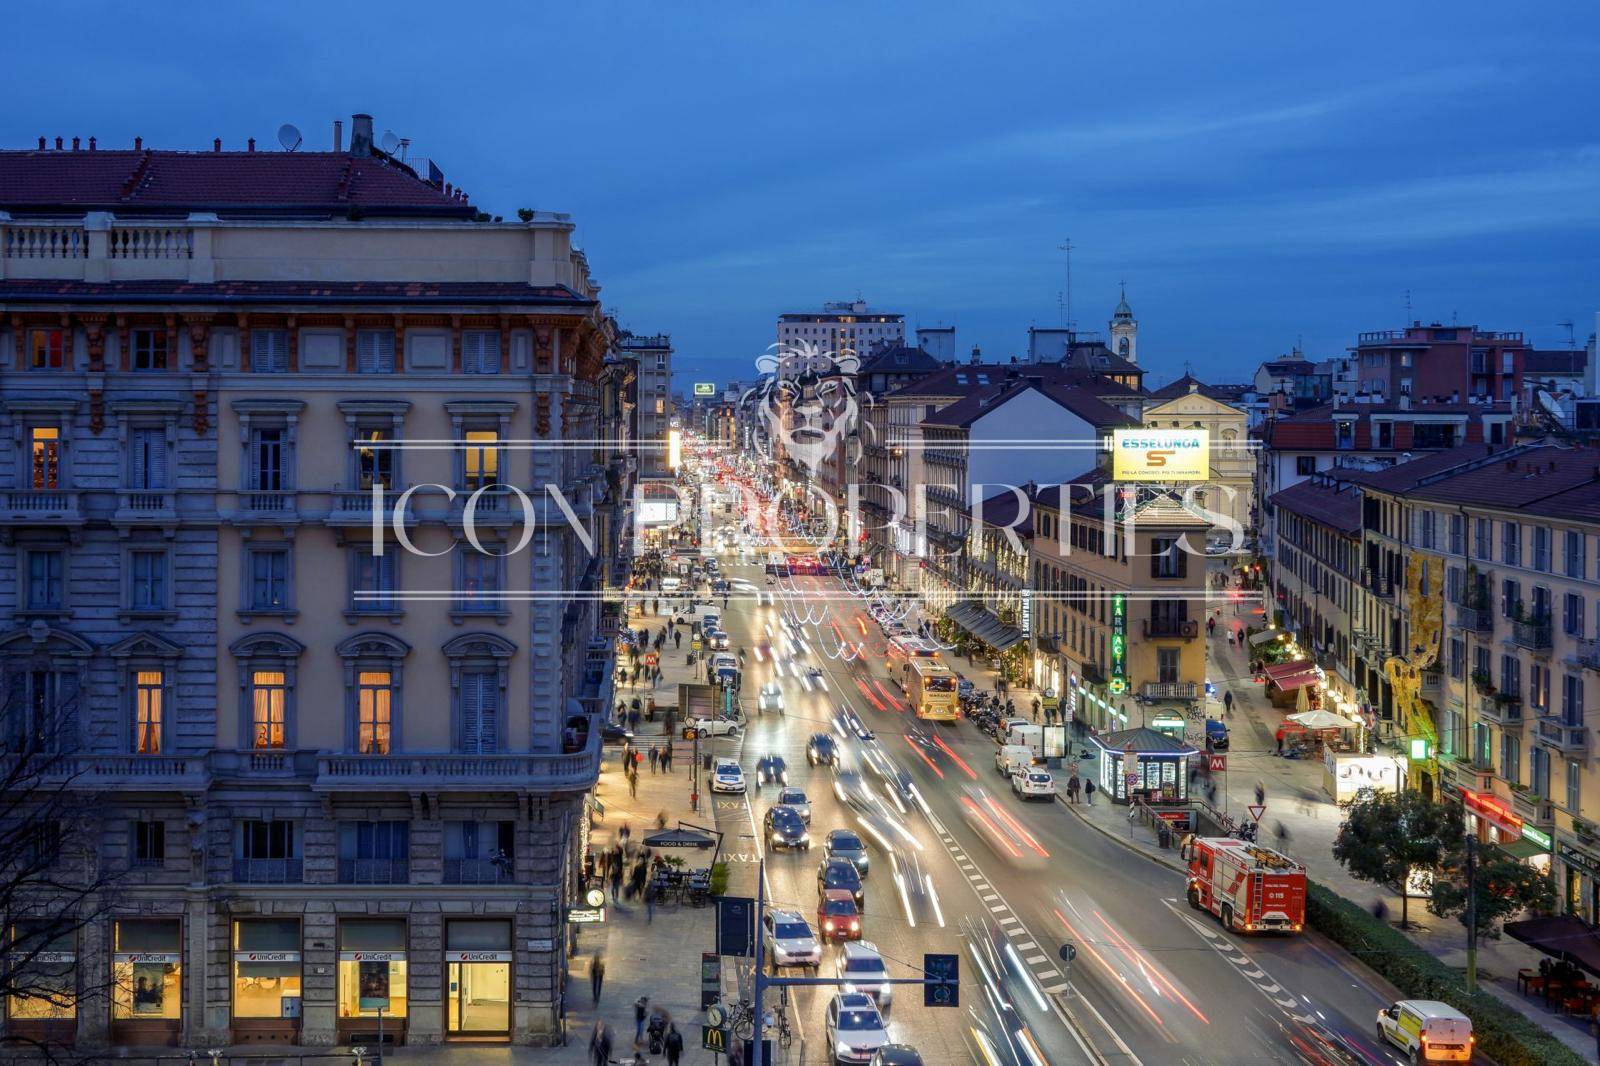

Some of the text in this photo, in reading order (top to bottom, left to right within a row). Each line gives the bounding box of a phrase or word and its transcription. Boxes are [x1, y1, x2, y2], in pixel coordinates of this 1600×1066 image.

[1122, 439, 1200, 448] ESSELUNGA
[1211, 760, 1224, 768] M
[723, 853, 760, 862] TAXI
[137, 953, 166, 962] UniCredit
[257, 952, 286, 961] UniCredit
[362, 952, 392, 961] UniCredit
[468, 953, 497, 961] UniCredit
